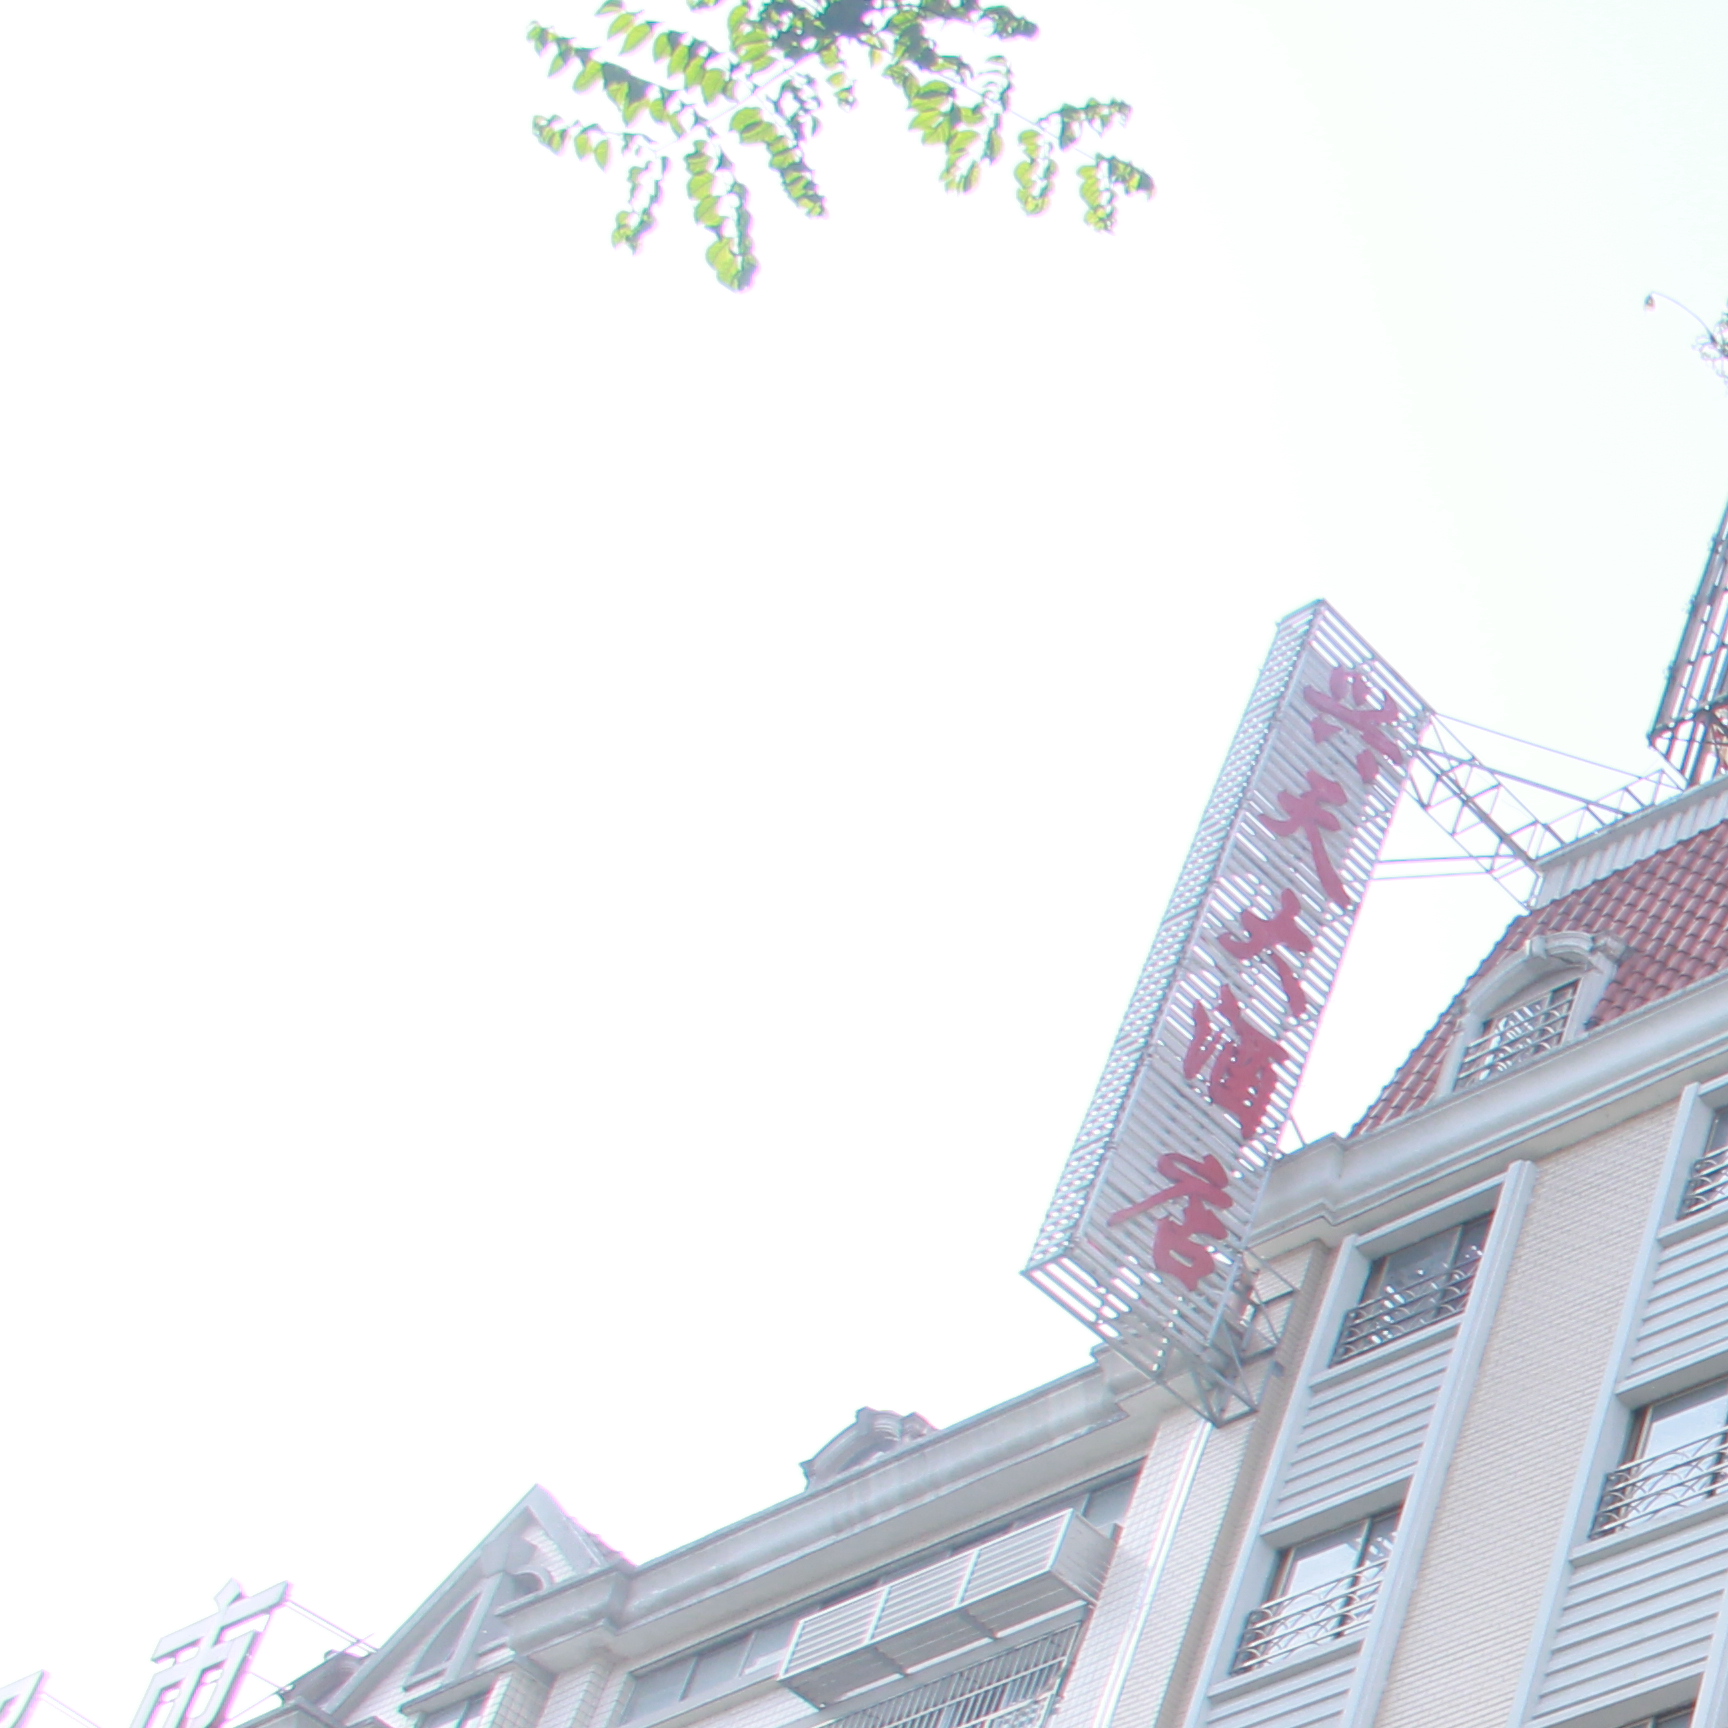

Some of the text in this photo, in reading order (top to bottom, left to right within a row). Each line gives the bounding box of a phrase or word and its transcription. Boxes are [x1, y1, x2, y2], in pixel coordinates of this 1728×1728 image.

[1107, 667, 1402, 1291] 兴天大酒店
